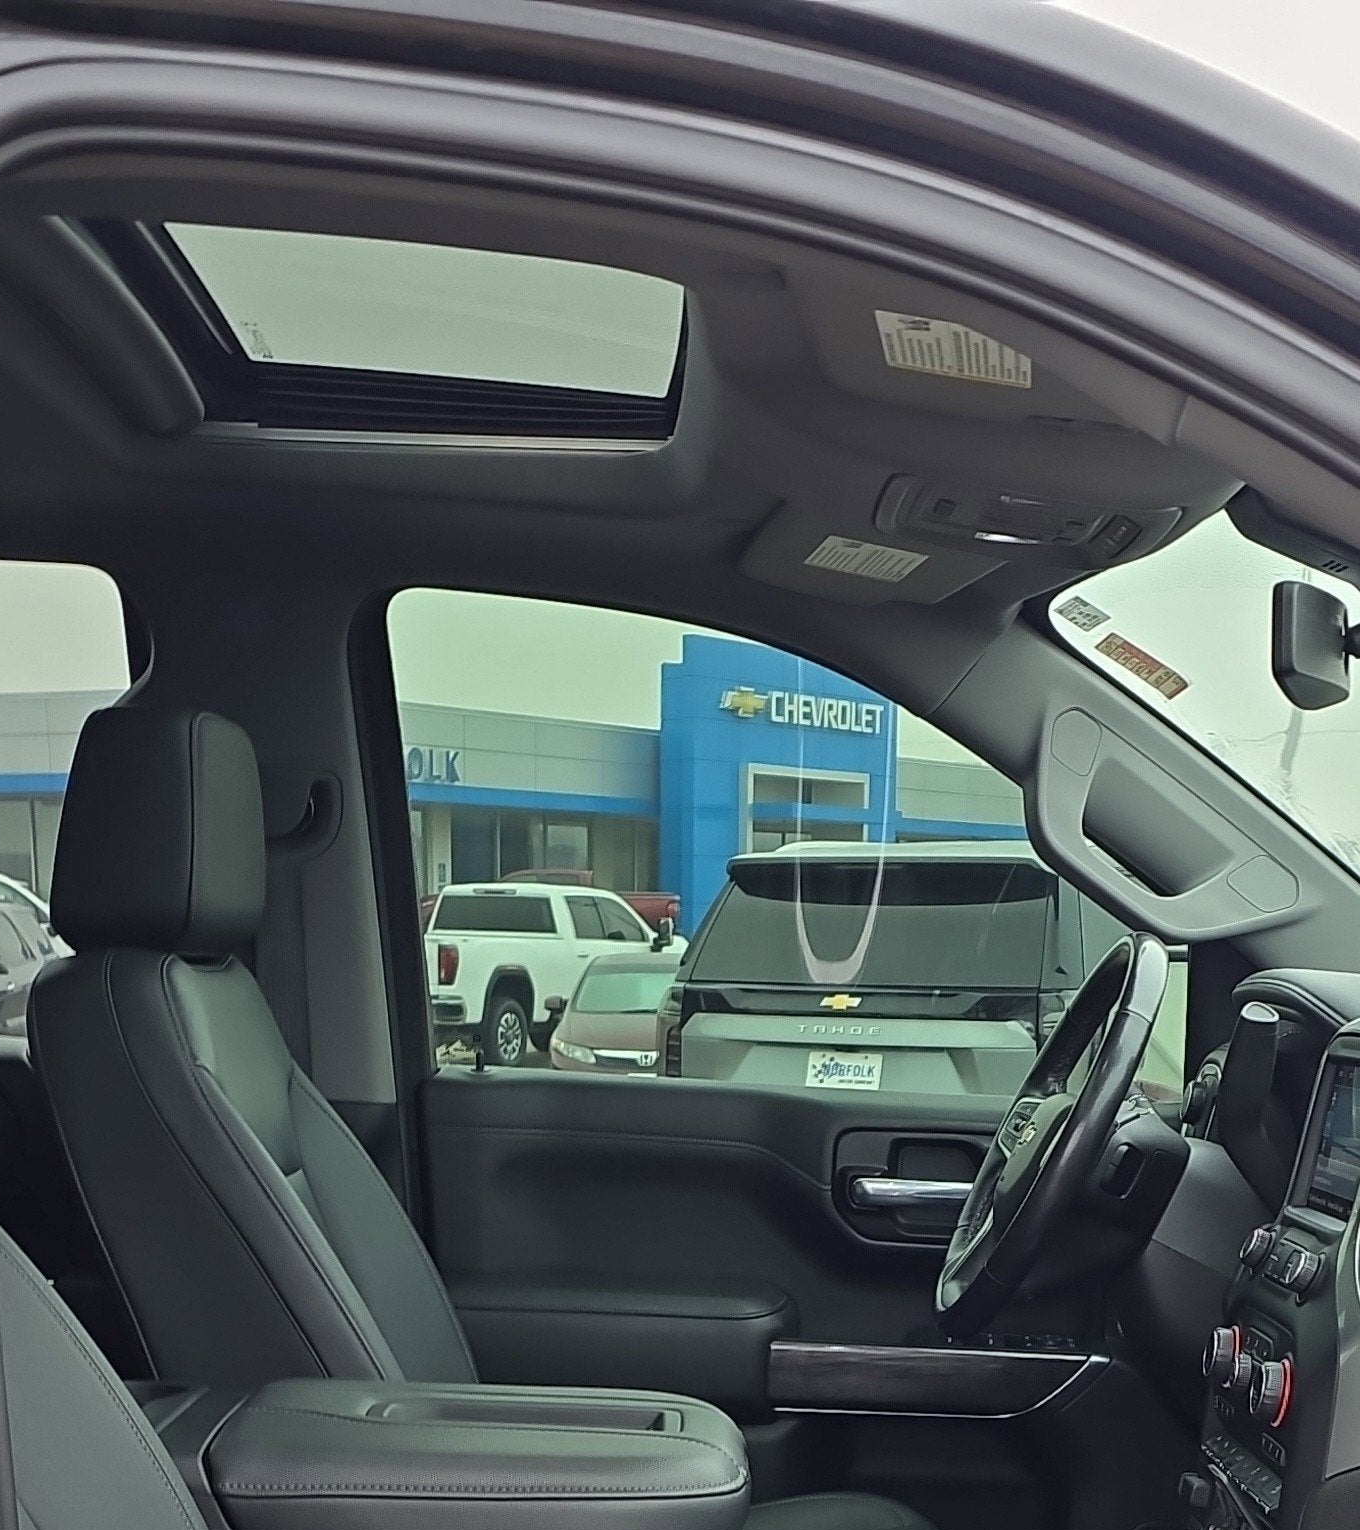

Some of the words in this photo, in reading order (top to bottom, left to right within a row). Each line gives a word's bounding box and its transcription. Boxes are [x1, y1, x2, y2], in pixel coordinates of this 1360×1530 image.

[771, 690, 885, 734] CHEVROLET
[798, 1024, 881, 1035] TAHOE
[822, 1061, 876, 1078] NORFOLK
